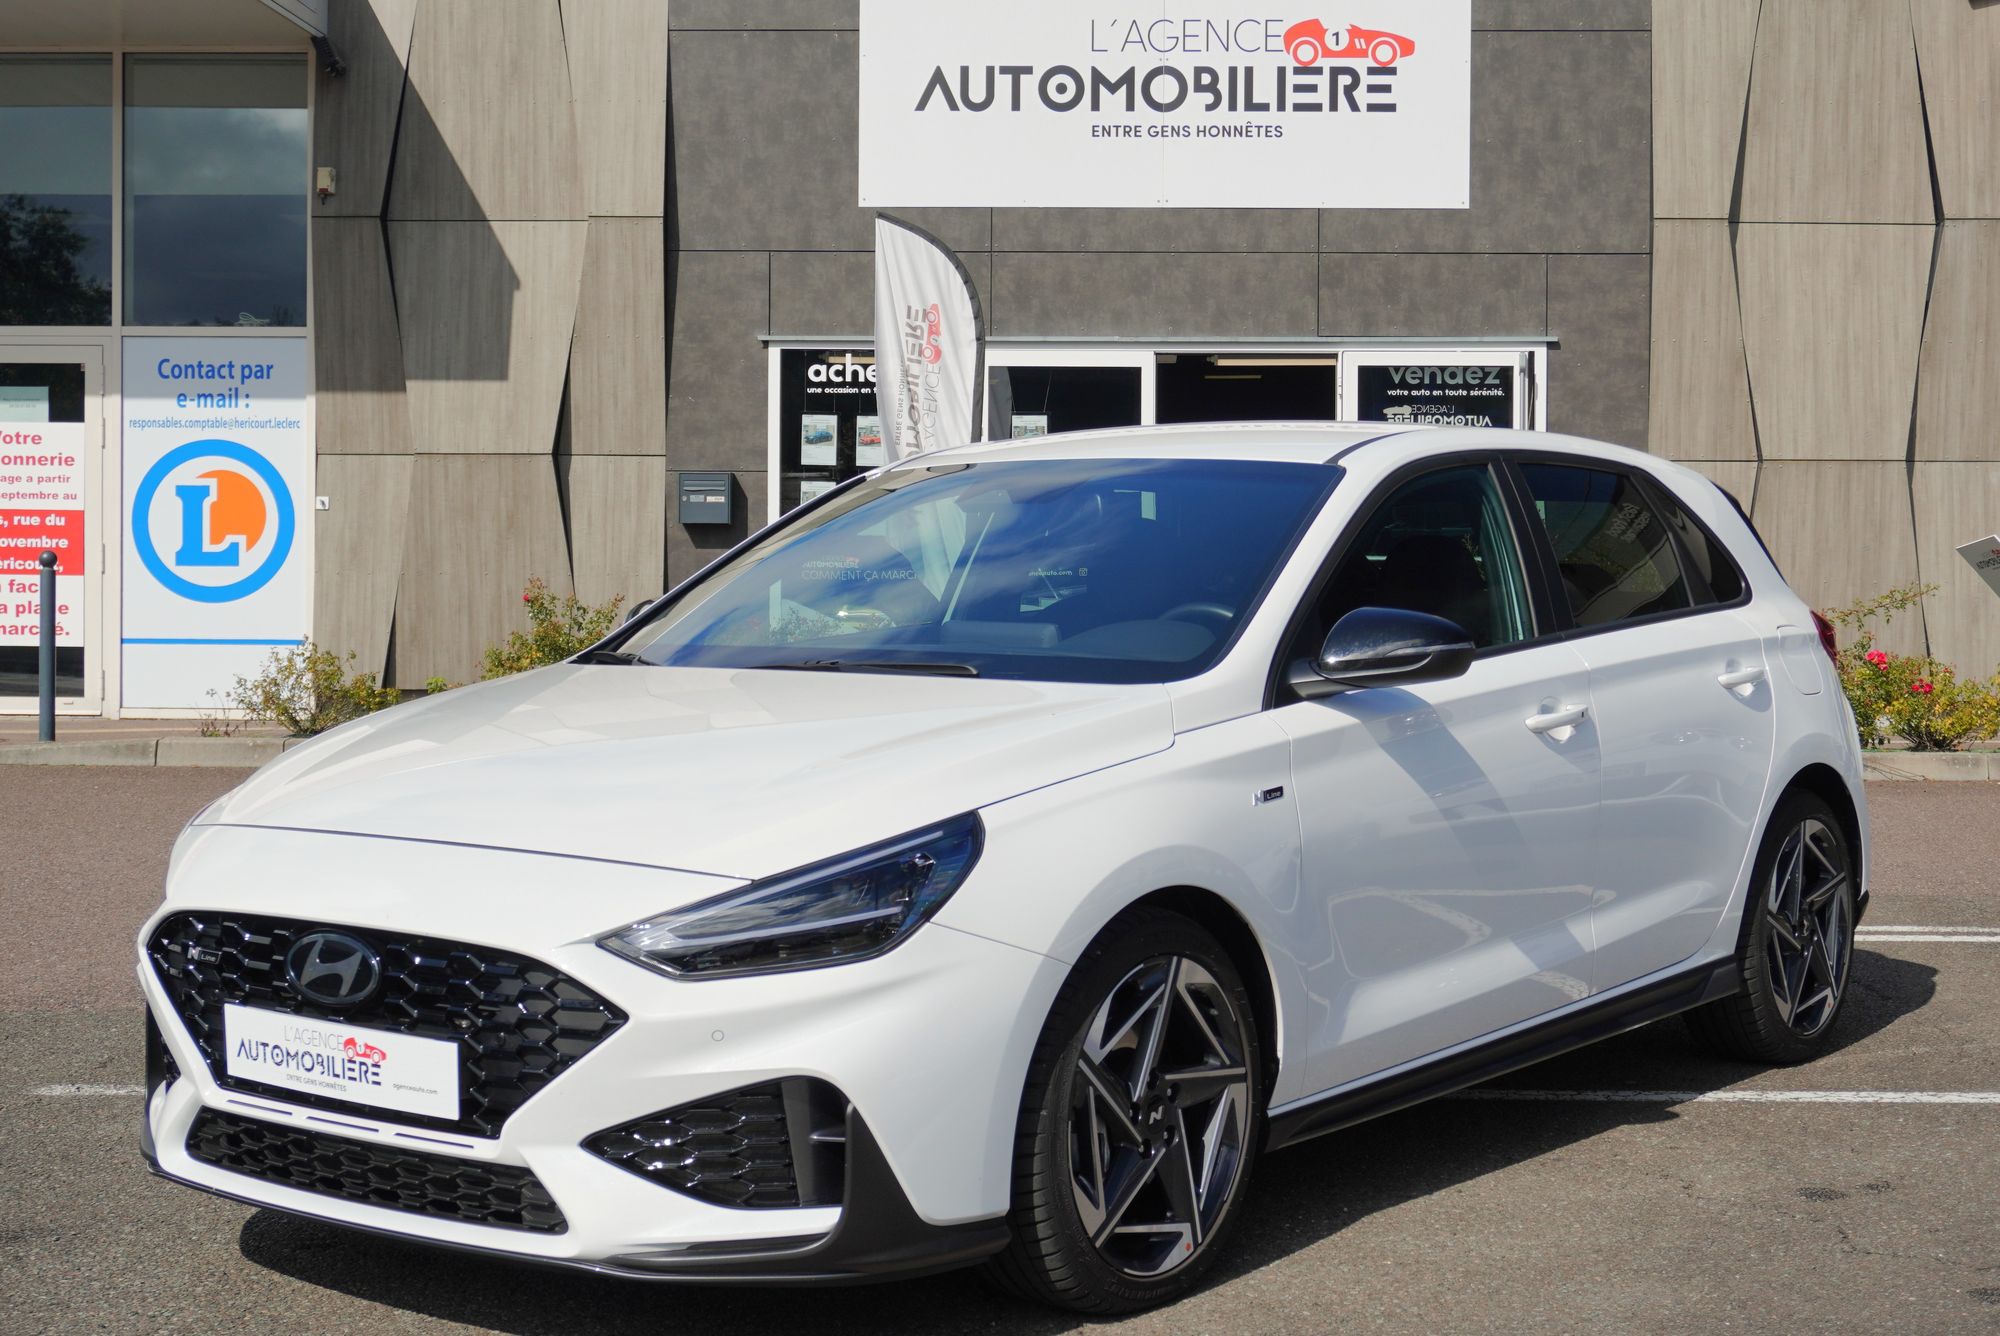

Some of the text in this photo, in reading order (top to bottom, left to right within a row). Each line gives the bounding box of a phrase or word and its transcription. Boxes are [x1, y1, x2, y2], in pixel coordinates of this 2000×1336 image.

[1091, 19, 1284, 53] L'AGENCE
[1091, 121, 1283, 138] ENTRE GENS HONNÊTES
[157, 358, 274, 385] Contact par
[807, 353, 877, 383] ache
[1388, 367, 1500, 385] vendez
[824, 386, 858, 394] occasion
[1469, 388, 1505, 396] sérénité.
[176, 387, 239, 409] e-mail
[129, 416, 301, 431] responsables.comptable@hericourt.leclerc
[0, 452, 75, 467] onnerie
[0, 474, 71, 485] age a partir
[0, 491, 77, 501] eptembre au
[13, 515, 41, 525] rue
[45, 513, 66, 526] du
[0, 535, 69, 548] ovembre
[802, 570, 861, 580] COMMENT
[863, 570, 879, 581] ÇA
[8, 579, 40, 593] fac
[15, 601, 69, 618] plae
[187, 946, 217, 962] N Line
[284, 1024, 344, 1051] L'AGENCE
